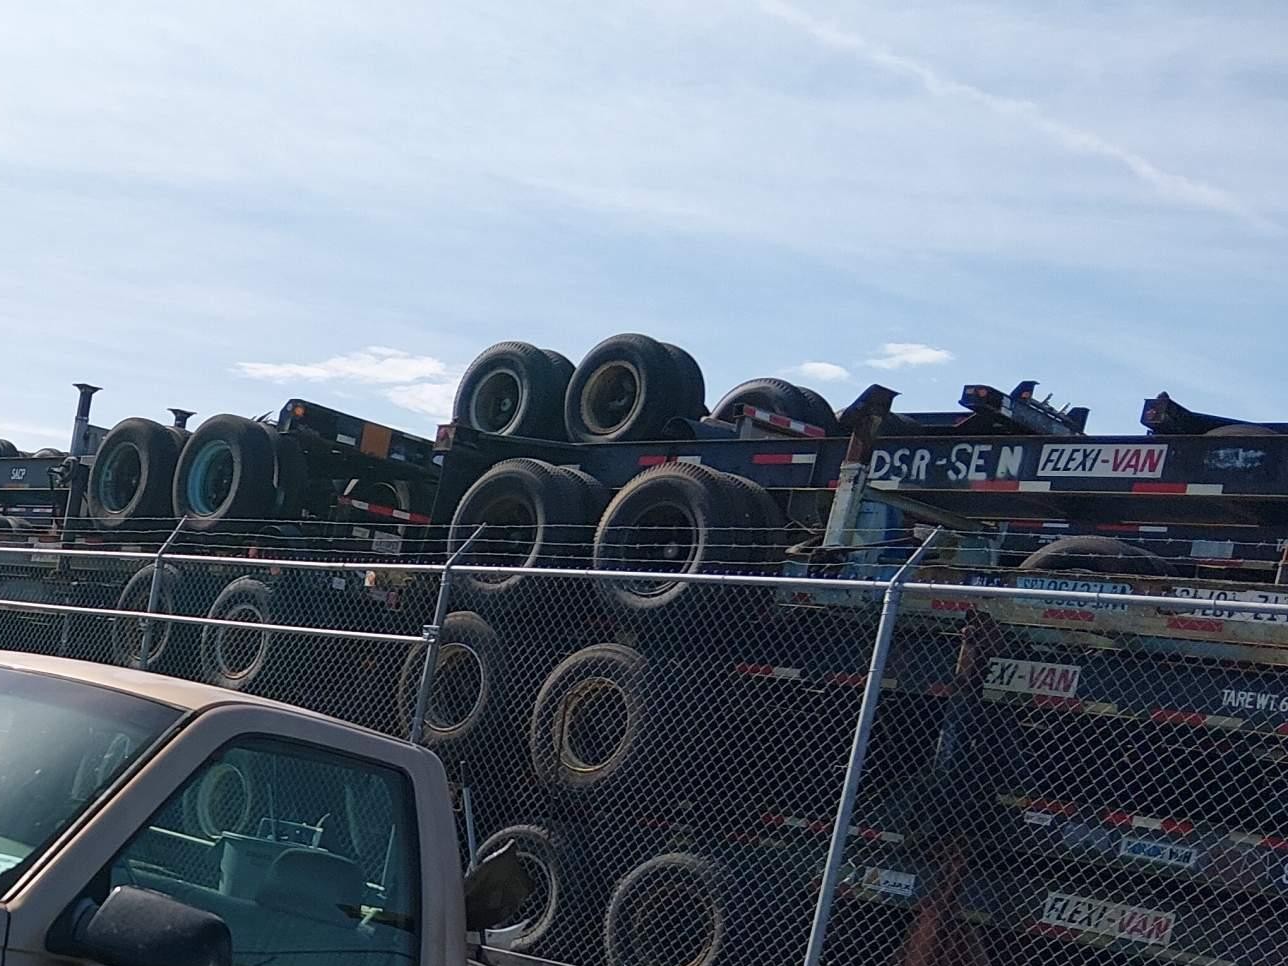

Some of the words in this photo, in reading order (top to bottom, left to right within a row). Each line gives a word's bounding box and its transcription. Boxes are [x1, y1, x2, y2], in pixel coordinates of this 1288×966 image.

[1040, 447, 1164, 475] FLEXI-VAN
[984, 661, 1078, 693] EXI-VAN
[1046, 897, 1172, 939] FLEXI-VAN
